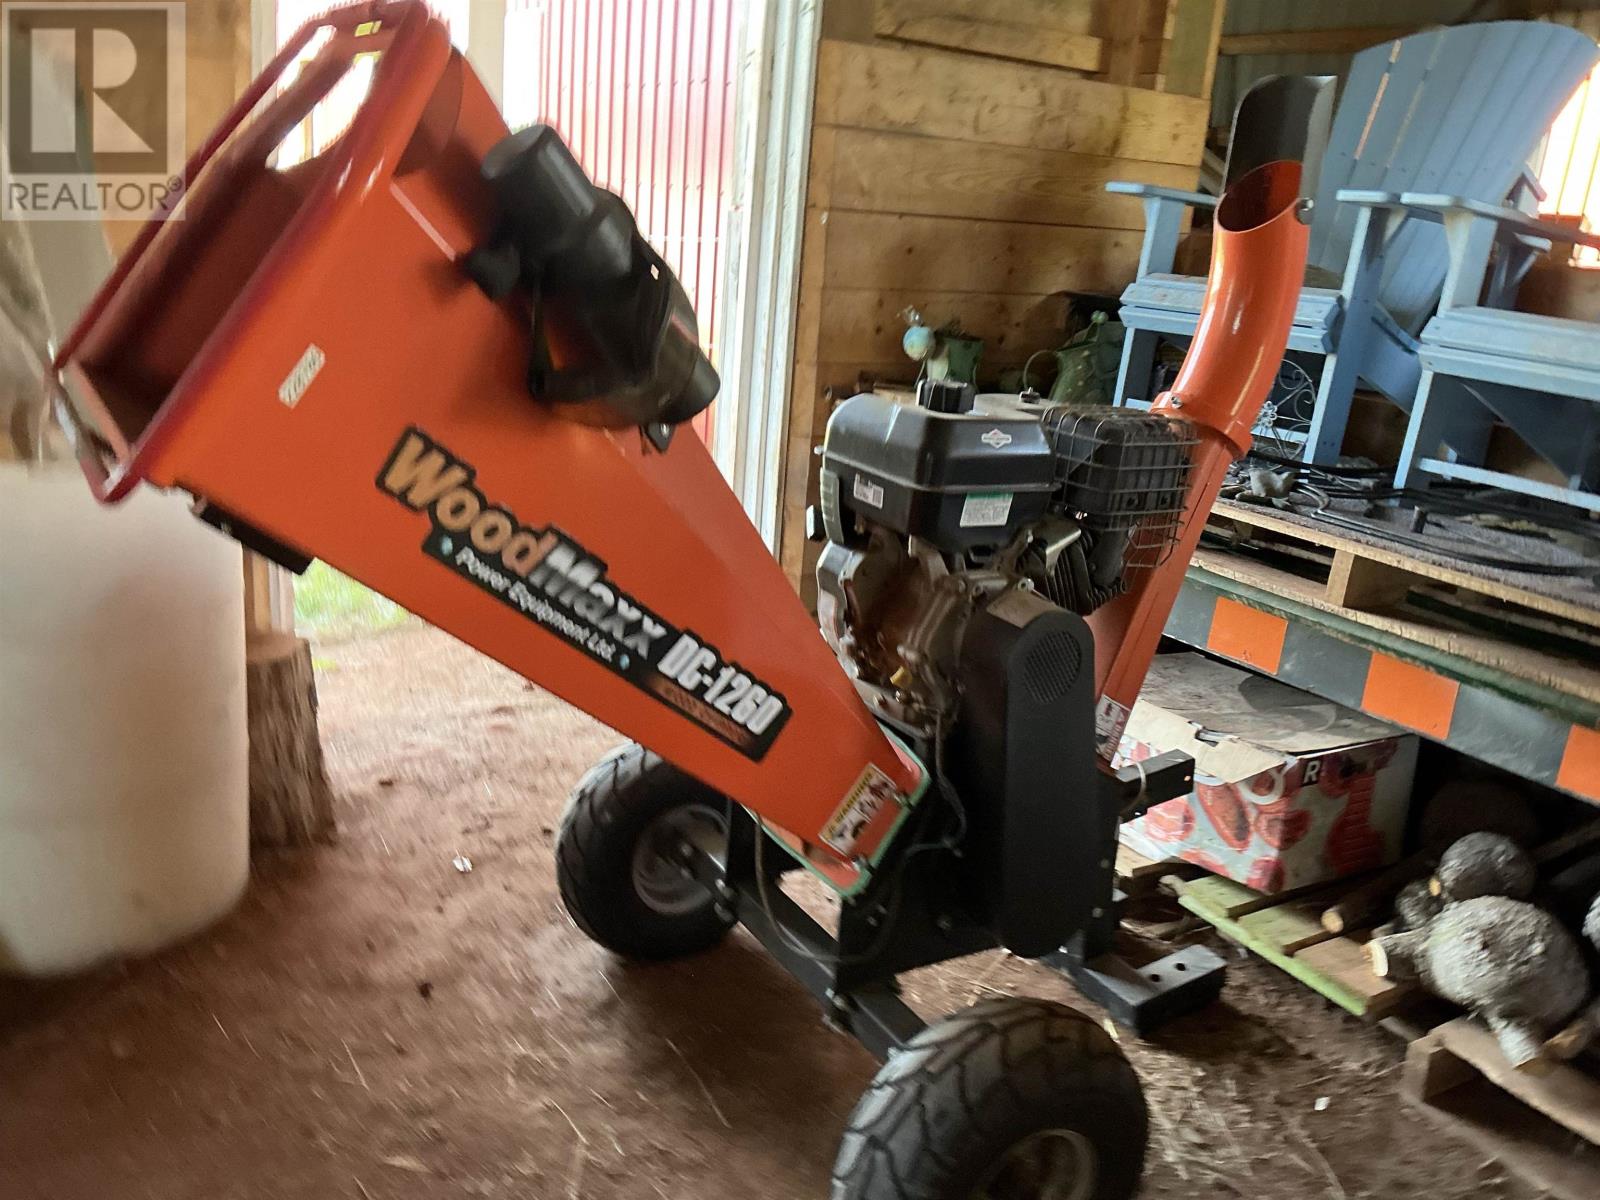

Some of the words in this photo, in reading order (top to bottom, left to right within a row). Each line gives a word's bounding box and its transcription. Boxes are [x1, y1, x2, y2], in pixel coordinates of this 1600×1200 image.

[384, 432, 666, 660] WoodMaxx
[657, 633, 784, 735] DC-1260
[455, 546, 512, 592] Power
[508, 580, 591, 644] Equipment
